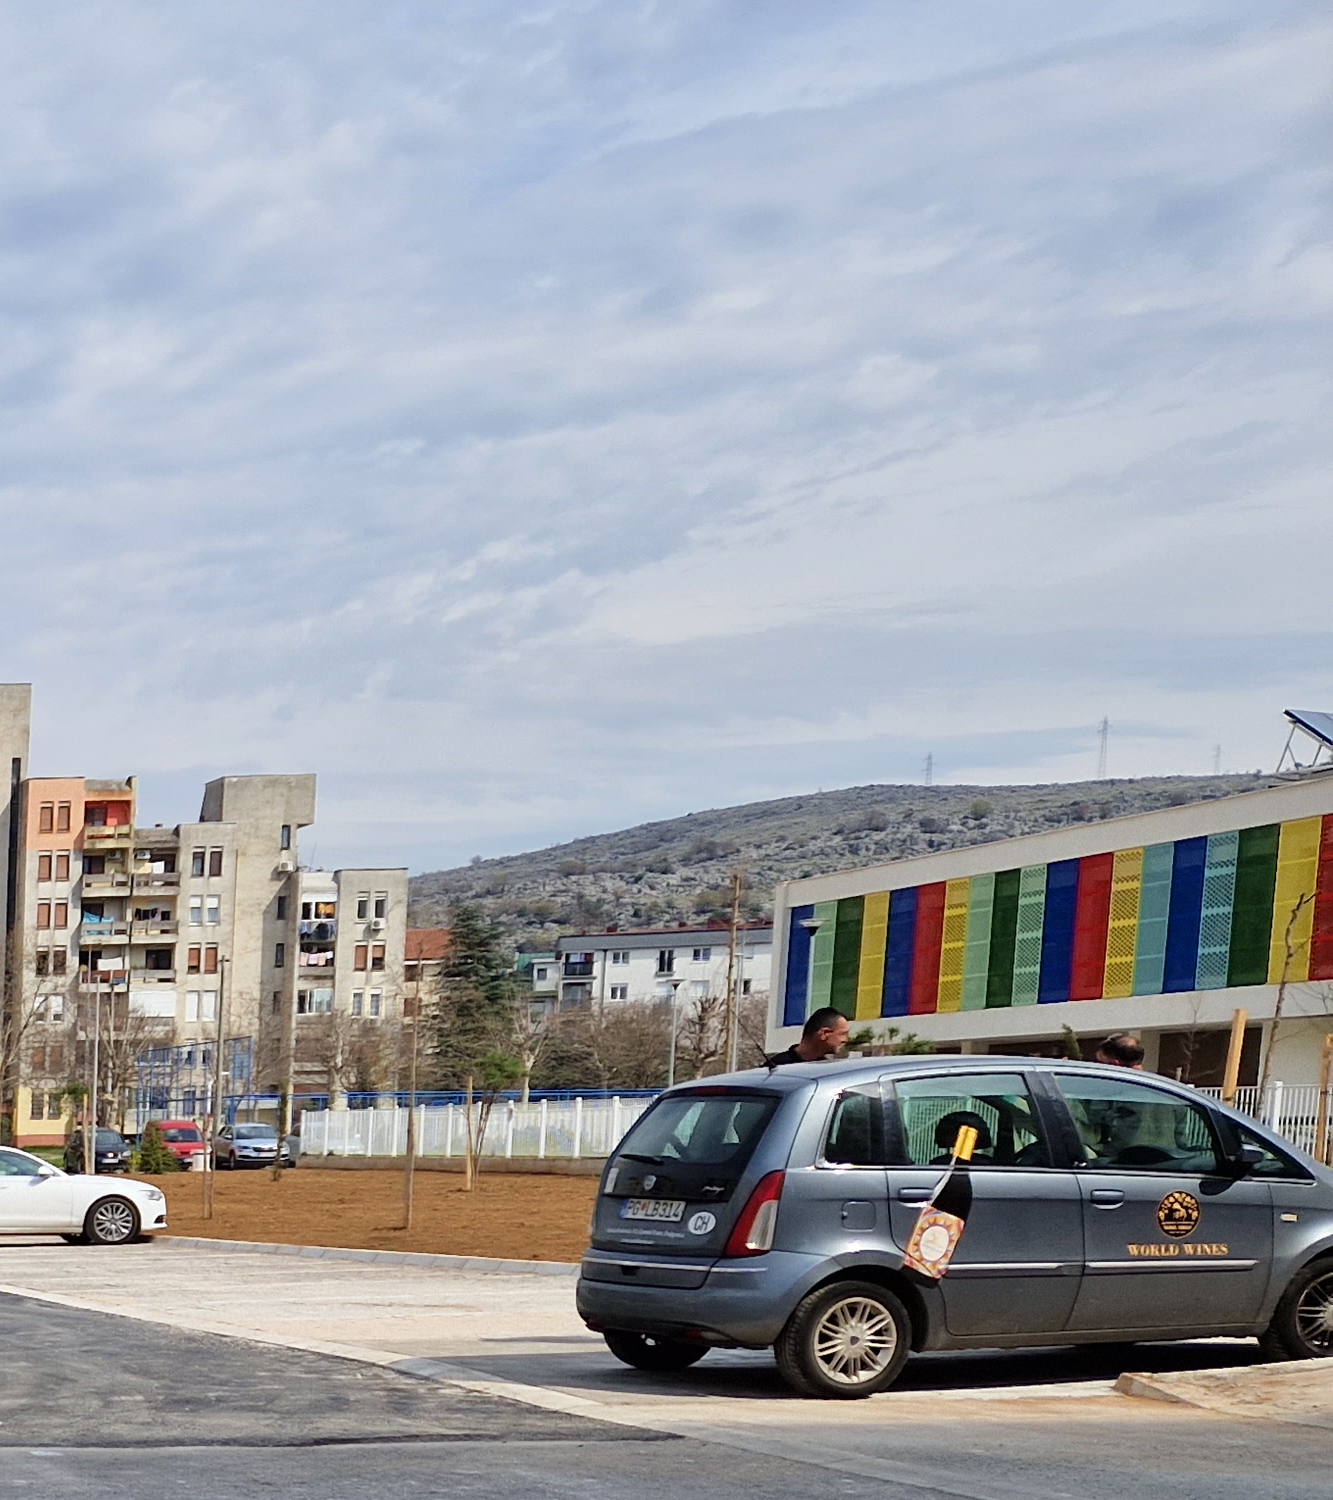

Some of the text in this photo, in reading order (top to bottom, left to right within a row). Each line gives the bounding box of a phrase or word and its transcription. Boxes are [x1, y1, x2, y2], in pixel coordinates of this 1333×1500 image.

[644, 1201, 682, 1219] LB314
[693, 1215, 711, 1232] CH
[1127, 1243, 1229, 1256] WORLD WINES
